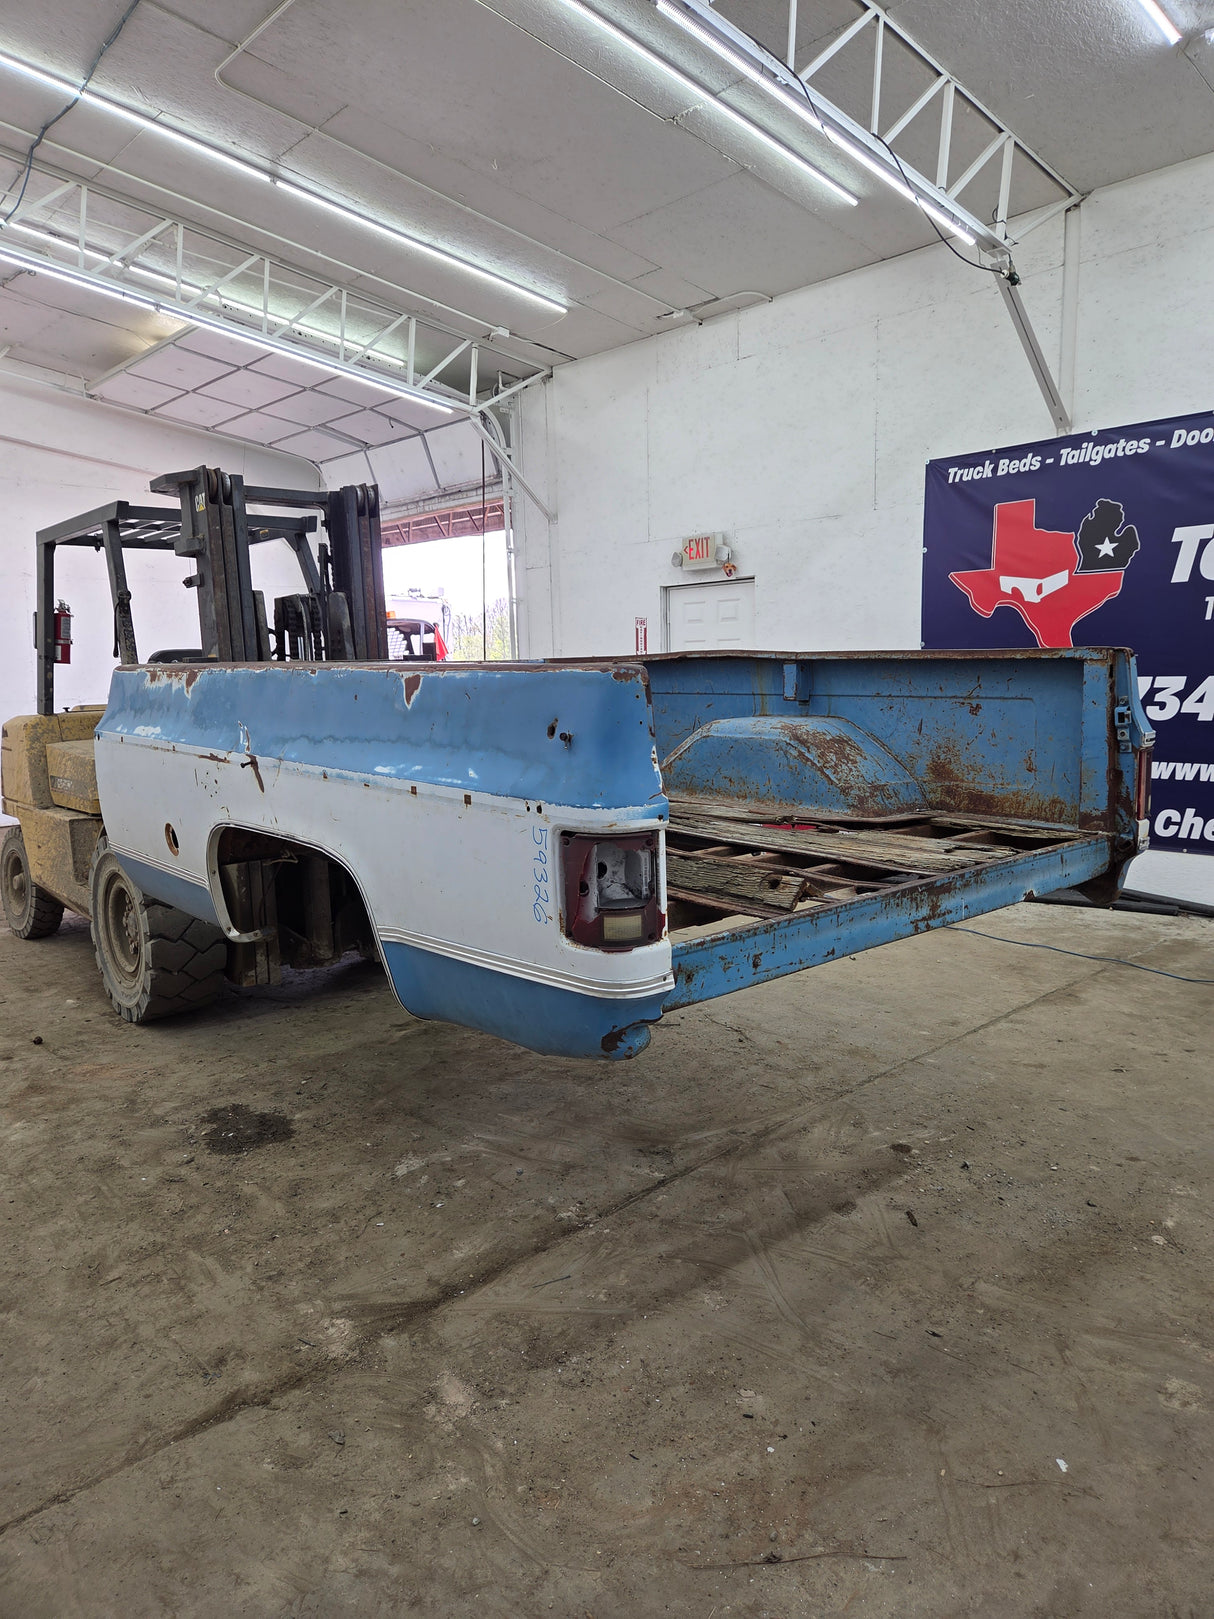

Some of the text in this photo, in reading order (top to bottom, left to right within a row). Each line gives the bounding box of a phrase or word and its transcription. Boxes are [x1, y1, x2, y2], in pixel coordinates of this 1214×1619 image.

[947, 460, 995, 484] Truck
[996, 452, 1042, 476] Beds
[1059, 438, 1151, 466] Tailgates
[1170, 427, 1214, 449] Doo
[194, 492, 206, 512] CAT
[688, 536, 710, 561] EXIT
[532, 825, 549, 925] 59326
